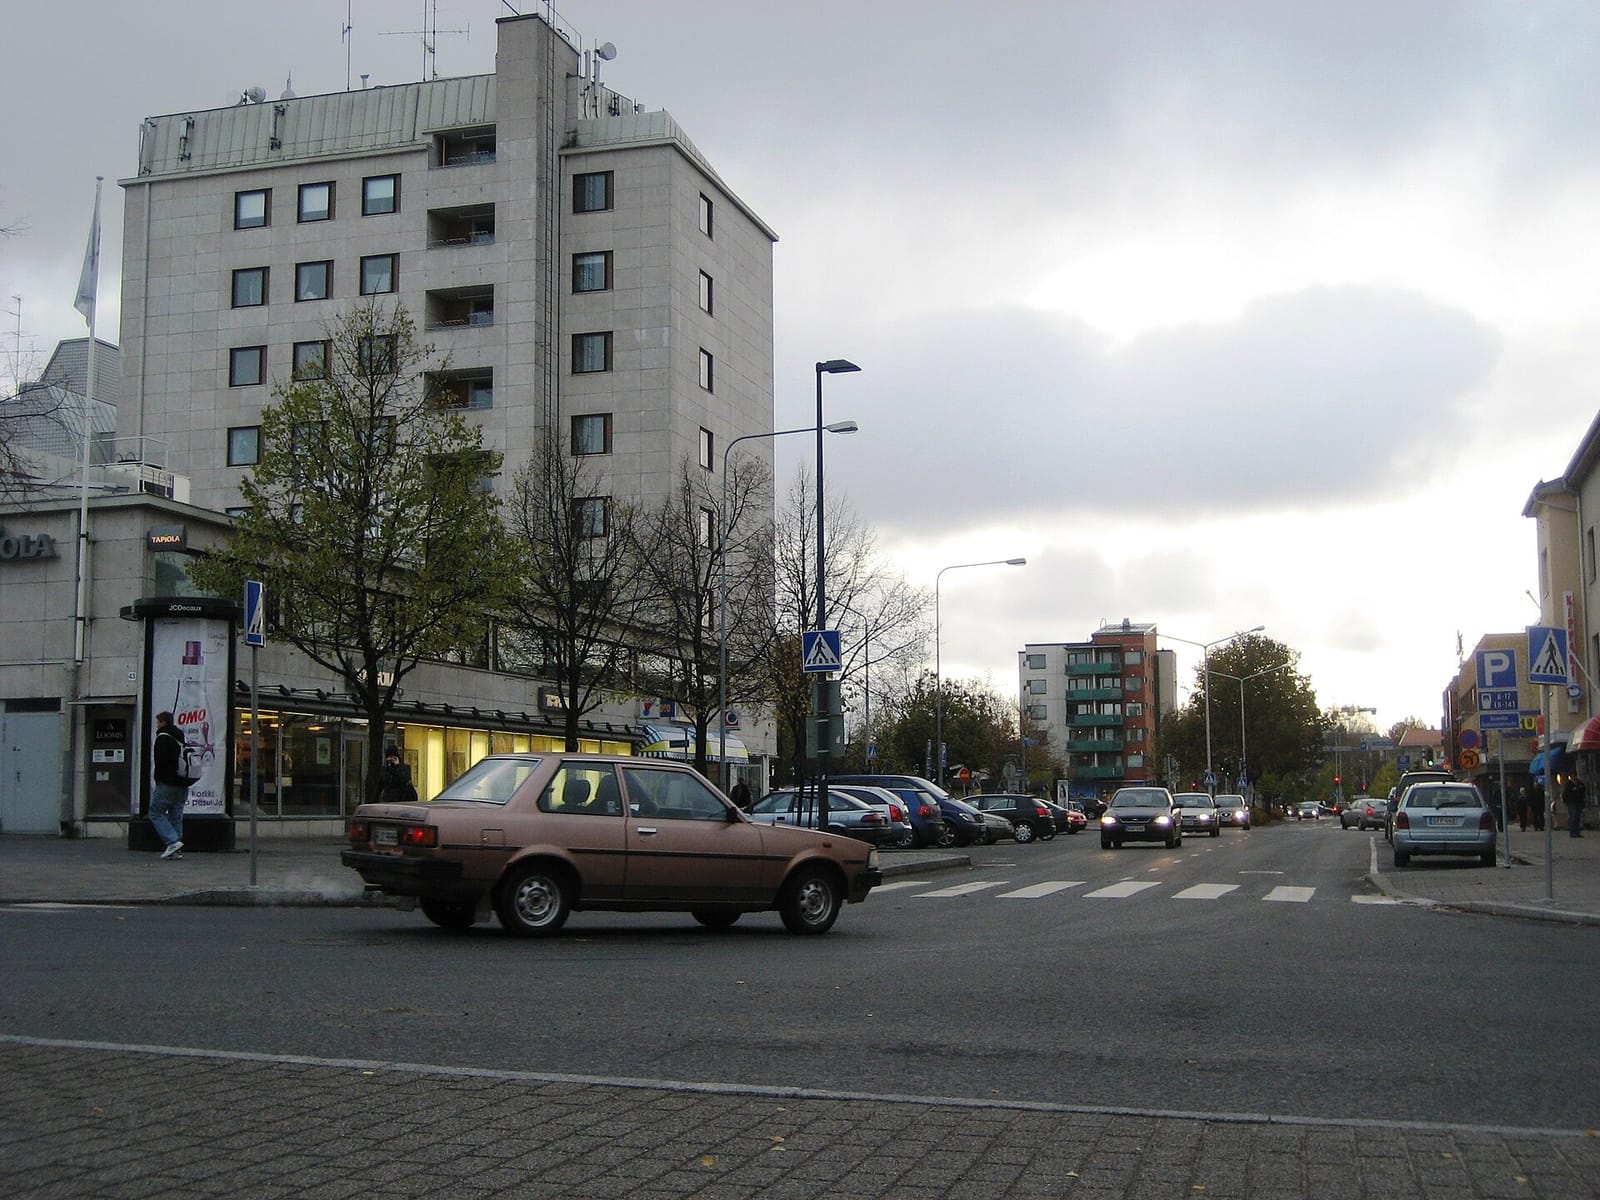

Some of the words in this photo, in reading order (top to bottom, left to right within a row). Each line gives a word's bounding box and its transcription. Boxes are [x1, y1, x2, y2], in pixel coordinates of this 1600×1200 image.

[151, 535, 181, 543] TAPIOLA
[1483, 653, 1510, 686] P
[178, 709, 206, 725] OMO
